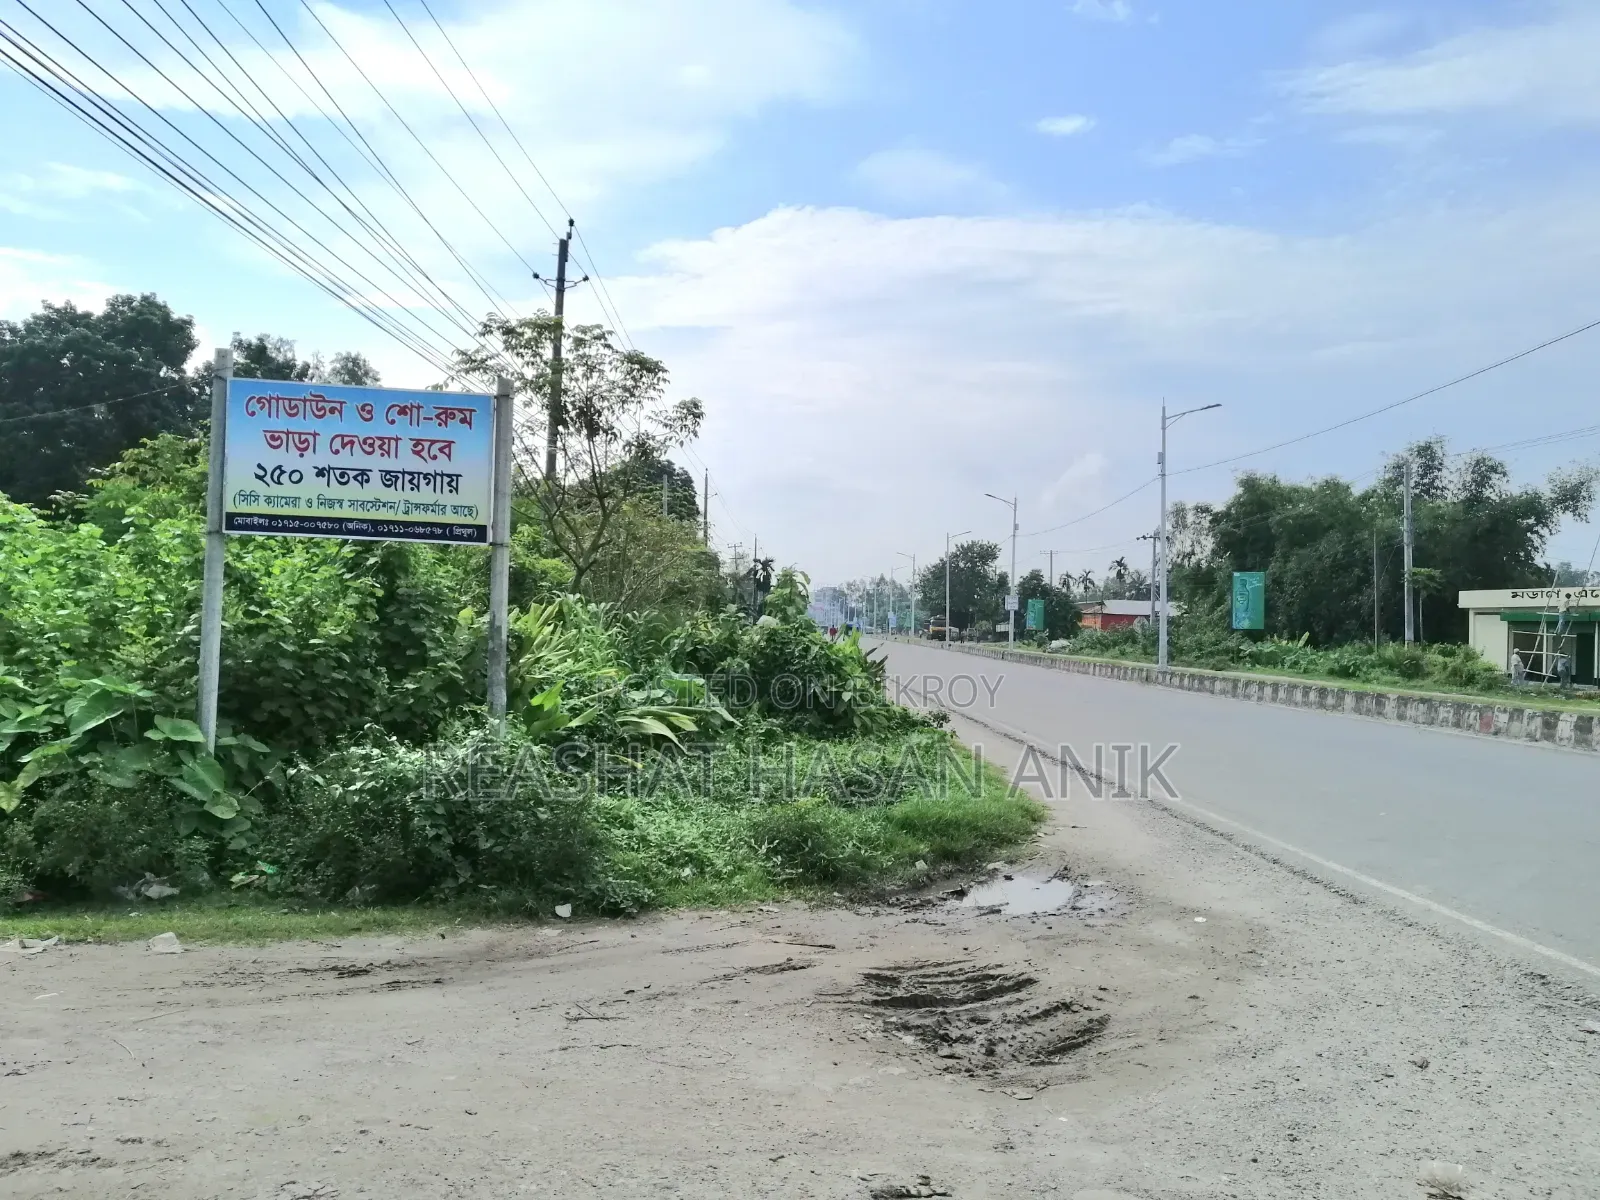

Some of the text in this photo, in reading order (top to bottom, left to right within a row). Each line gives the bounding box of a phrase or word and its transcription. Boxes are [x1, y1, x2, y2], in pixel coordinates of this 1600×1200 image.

[245, 391, 477, 430] গোডাউন ও শো-রুম
[262, 428, 456, 464] ভাড়া দেওয়া হবে
[253, 462, 463, 495] ২৫০ শতক জায়গায়
[232, 489, 261, 509] (সিসি
[263, 494, 302, 509] ক্যামেরা
[305, 497, 313, 509] ও
[317, 493, 345, 510] নিজস্ব
[450, 504, 479, 520] আছে)
